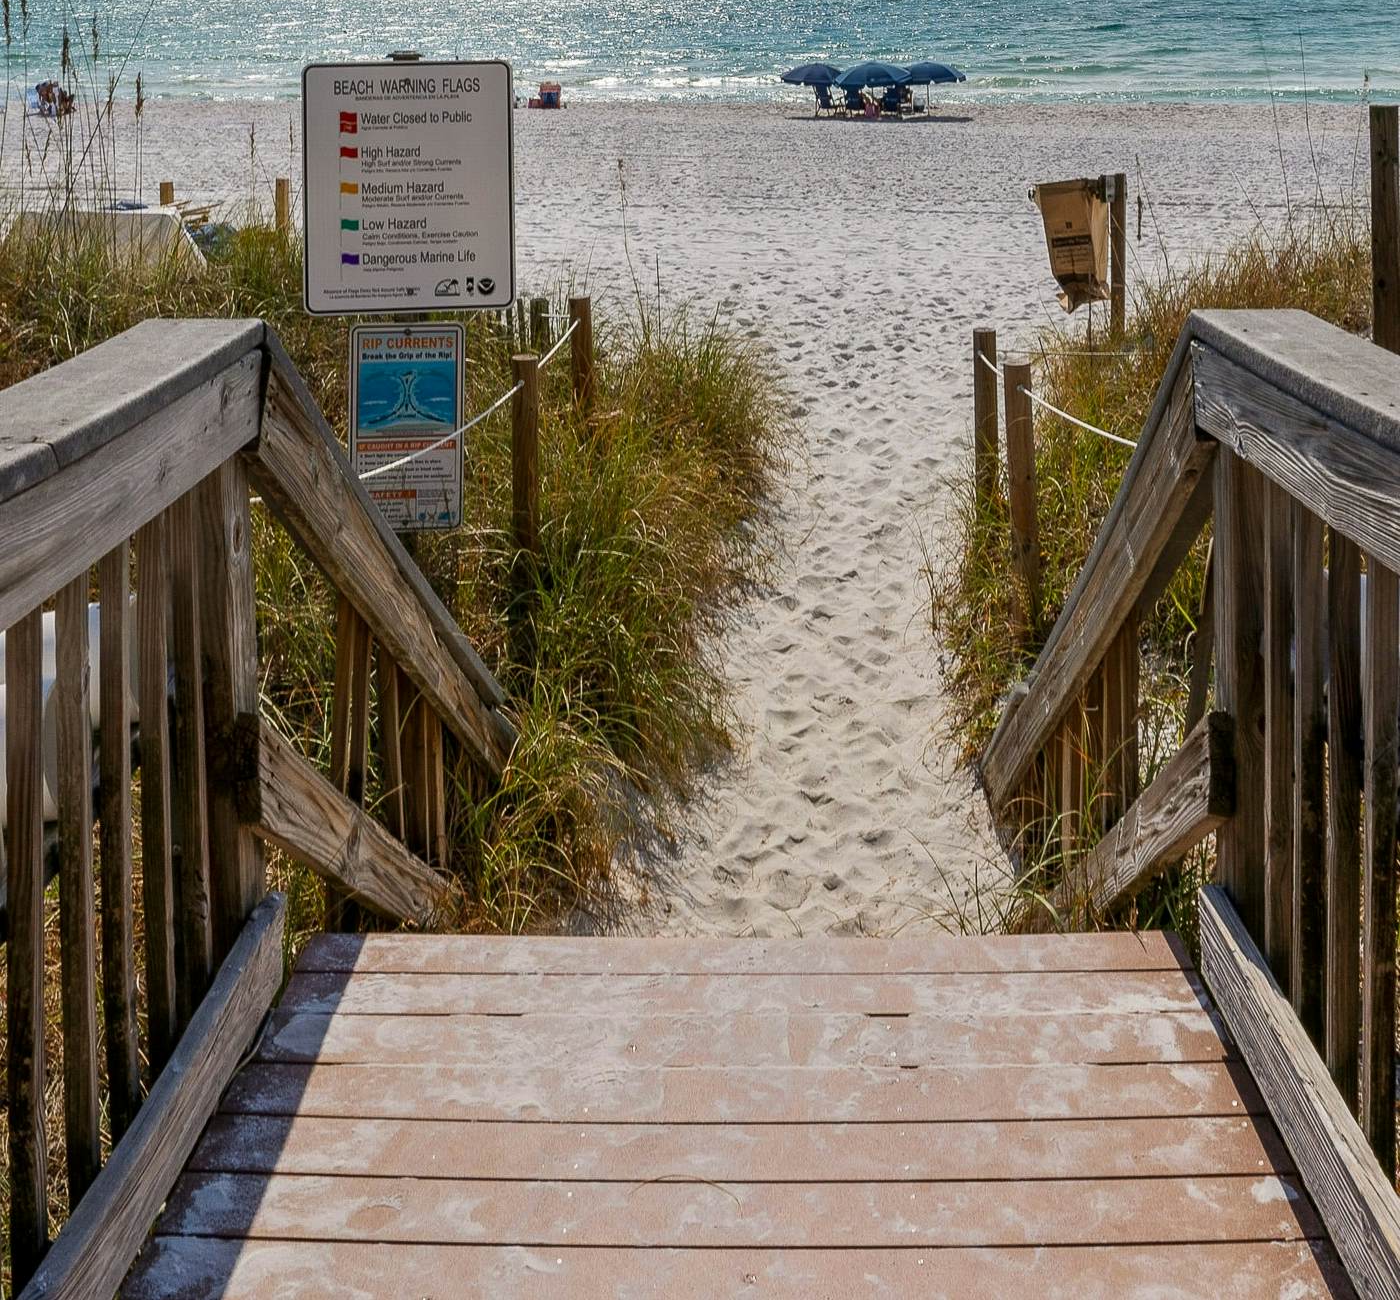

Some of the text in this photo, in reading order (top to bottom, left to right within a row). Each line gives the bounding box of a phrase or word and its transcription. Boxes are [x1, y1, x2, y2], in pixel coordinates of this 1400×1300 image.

[333, 77, 481, 96] BEACH WARNING FLAGS
[360, 110, 472, 125] Water Closed to Public
[360, 146, 421, 160] High Hazard
[412, 159, 434, 168] Strong
[361, 181, 444, 194] Medium Hazard
[362, 195, 394, 203] Moderate
[395, 194, 410, 202] Surf
[412, 194, 433, 202] and/or
[362, 218, 427, 230] Low Hazard
[362, 232, 380, 240] Calm
[362, 250, 476, 267] Dangerous Marine Life
[362, 337, 453, 350] RIP CURRENTS
[398, 352, 413, 360] Grip
[438, 351, 452, 359] Rip!
